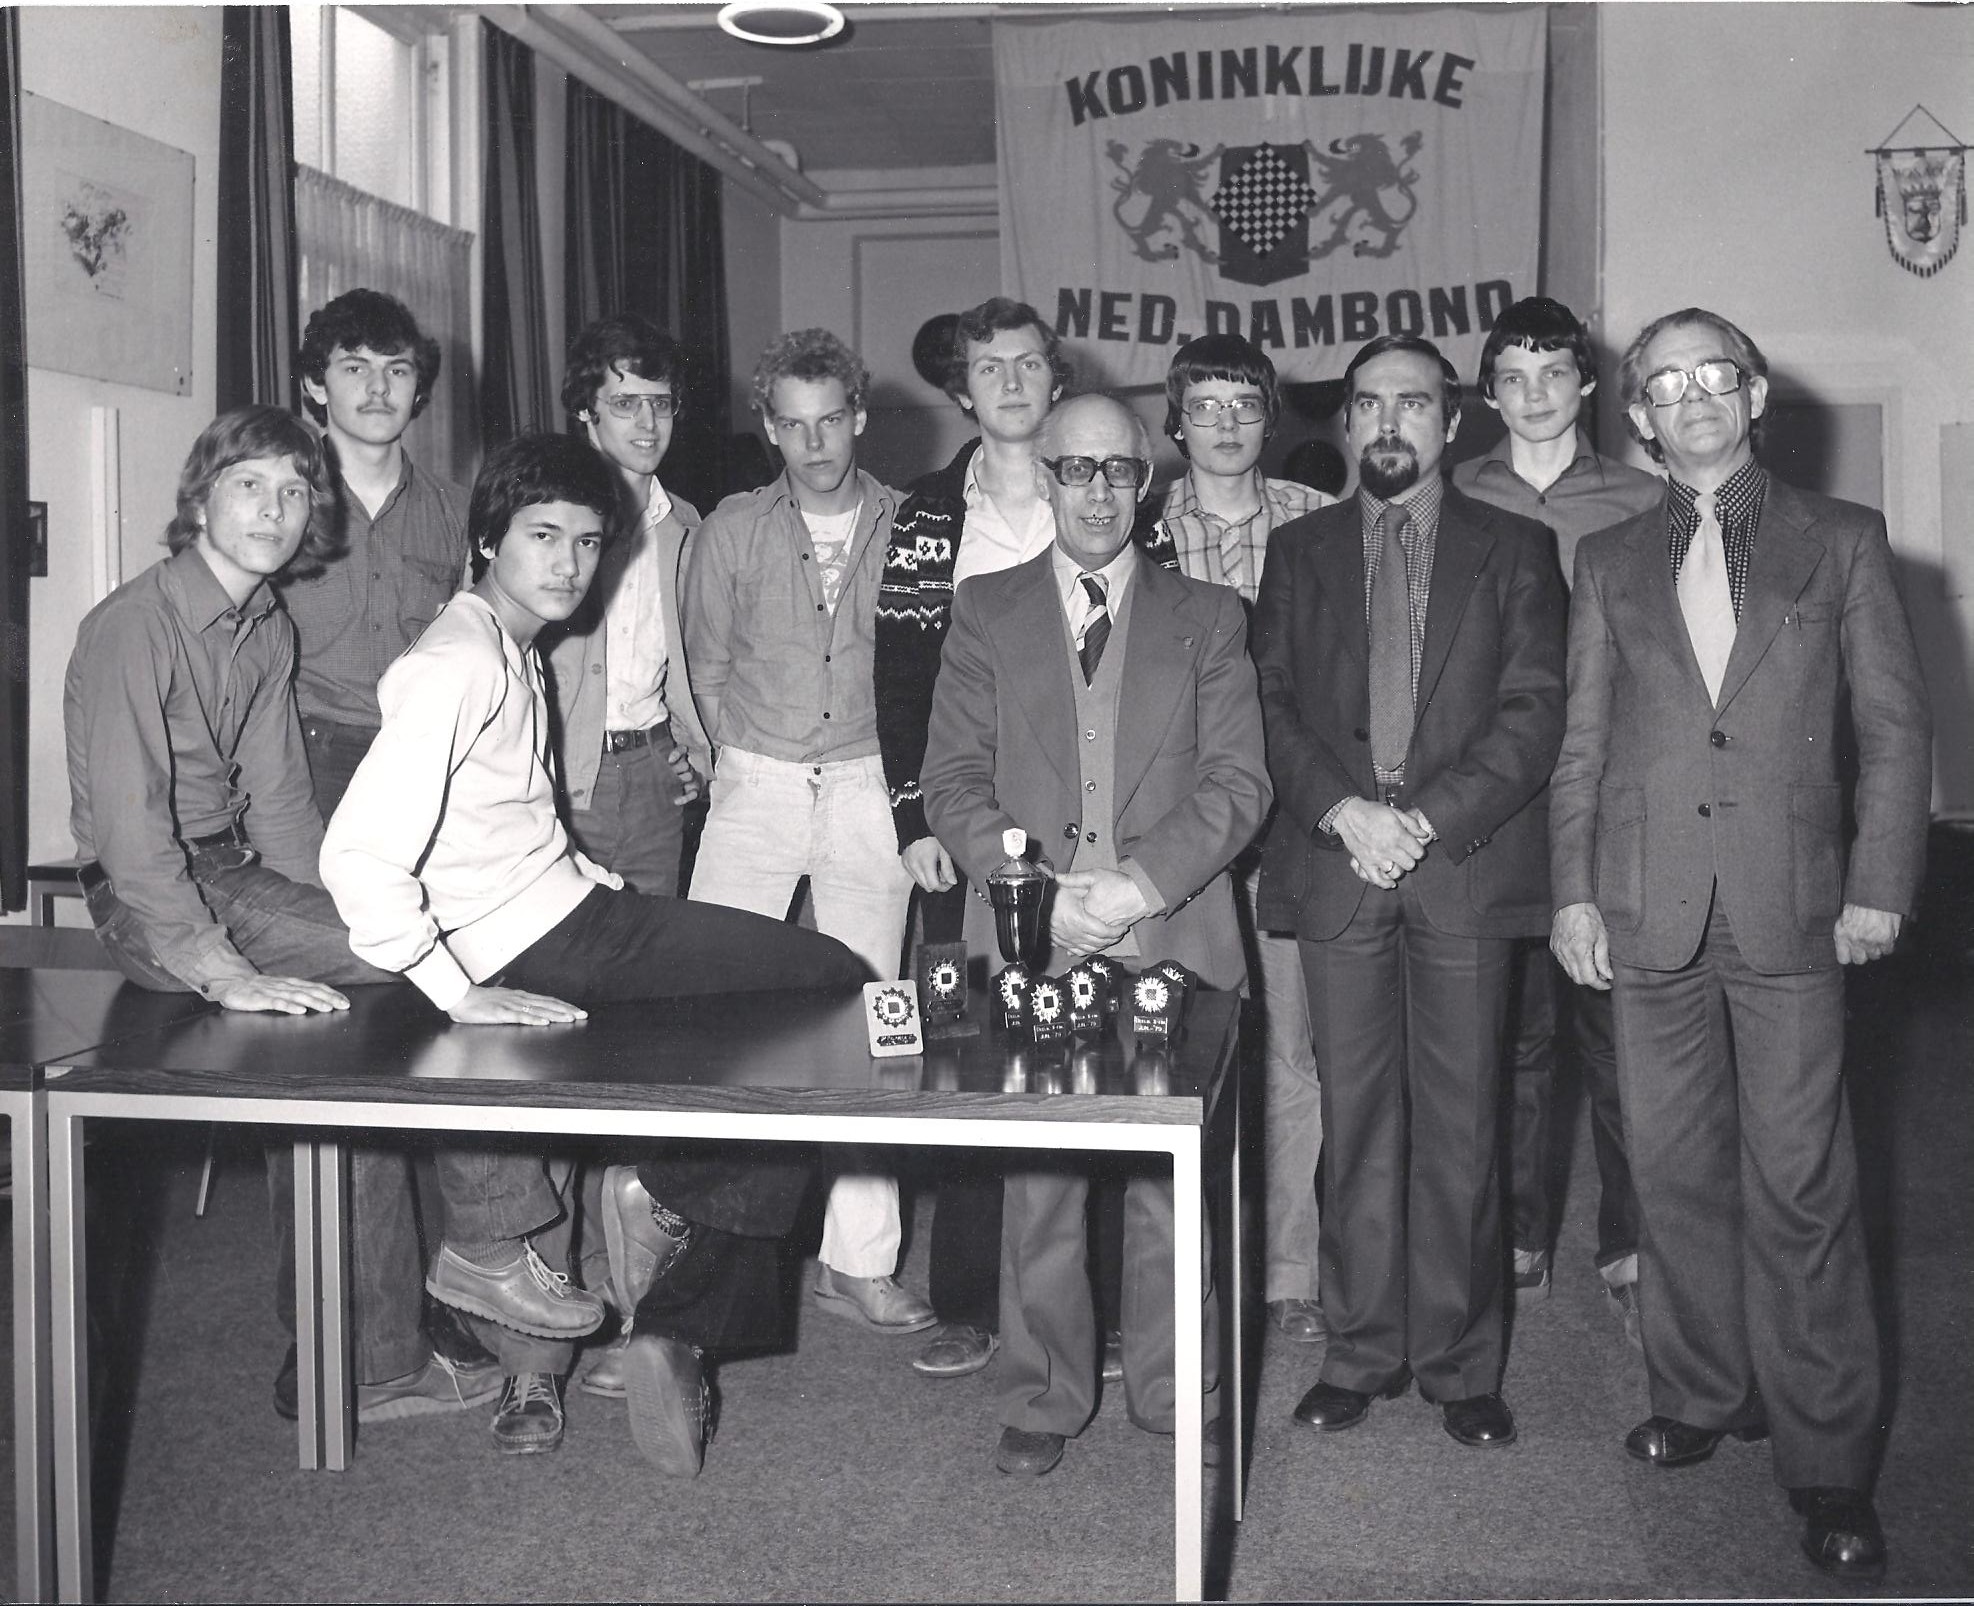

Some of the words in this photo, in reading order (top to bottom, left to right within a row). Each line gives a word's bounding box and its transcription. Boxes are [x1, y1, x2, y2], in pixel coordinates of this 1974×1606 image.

[1065, 43, 1476, 127] KONINKLIJKE
[1056, 287, 1192, 346] NED.
[1206, 279, 1514, 350] DAMBOND
